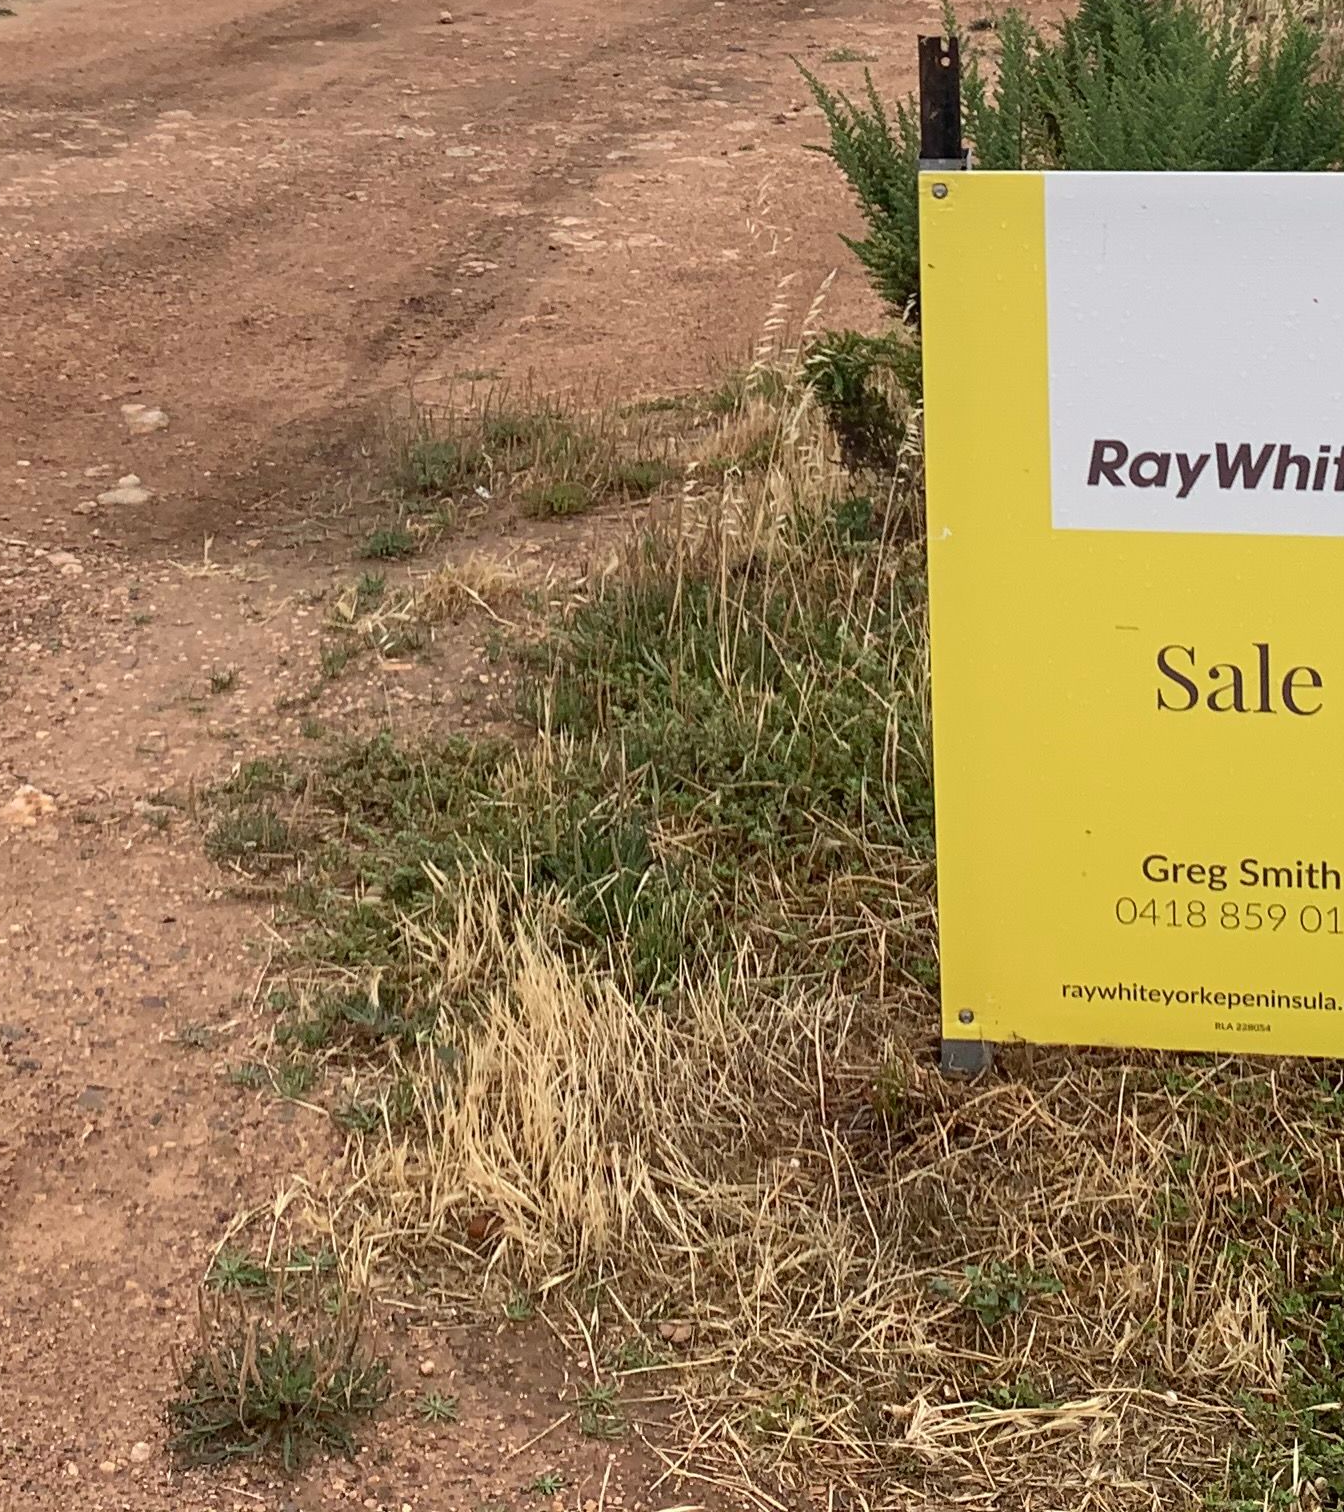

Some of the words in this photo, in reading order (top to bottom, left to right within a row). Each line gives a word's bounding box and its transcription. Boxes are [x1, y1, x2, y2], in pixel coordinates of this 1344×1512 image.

[1156, 642, 1324, 717] Sale
[1141, 854, 1228, 892] Greg
[1239, 858, 1342, 891] Smith
[1115, 896, 1207, 929] 0418
[1219, 901, 1288, 933] 859
[1214, 1022, 1234, 1031] RLA
